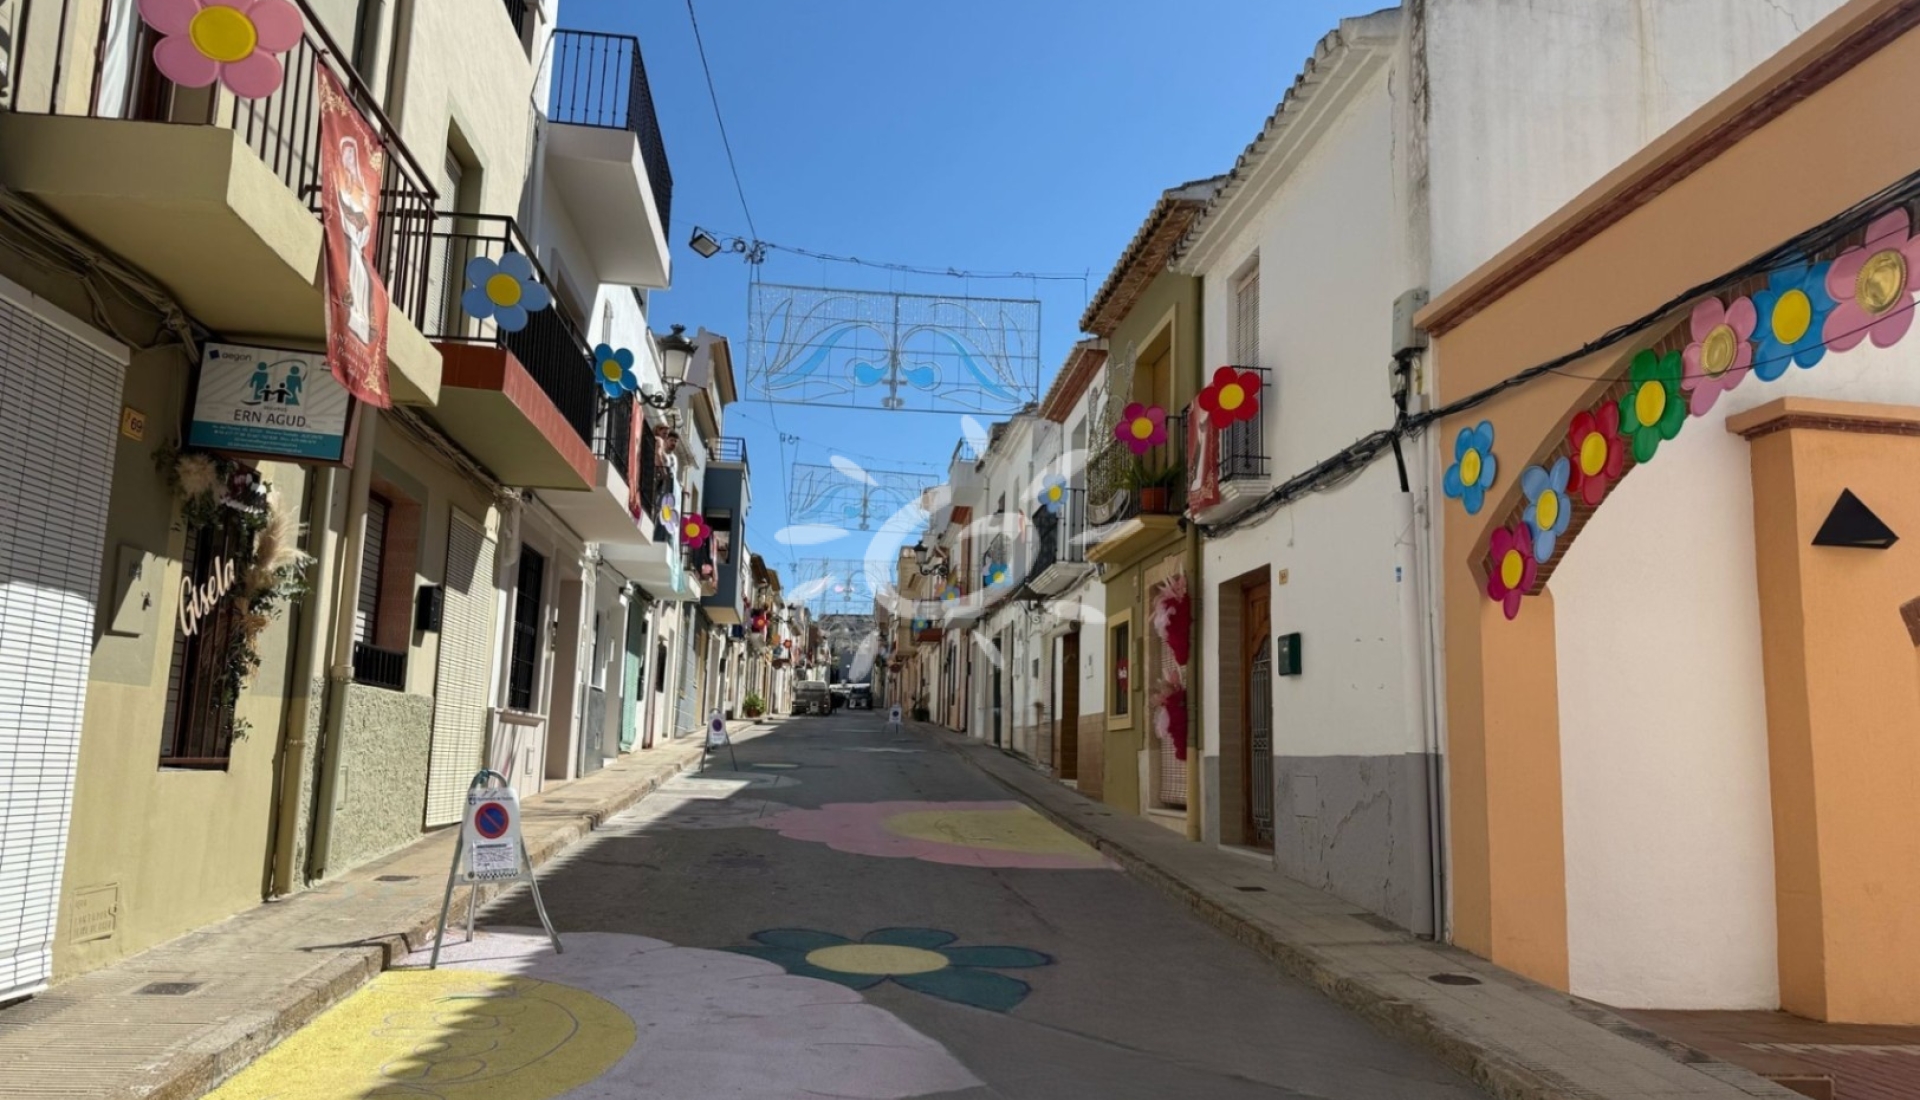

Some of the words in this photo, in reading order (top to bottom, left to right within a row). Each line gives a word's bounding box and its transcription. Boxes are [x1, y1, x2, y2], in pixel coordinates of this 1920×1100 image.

[221, 350, 252, 362] aegon
[233, 408, 262, 423] ERN
[266, 412, 306, 428] AGUD
[178, 555, 235, 636] Gisela
